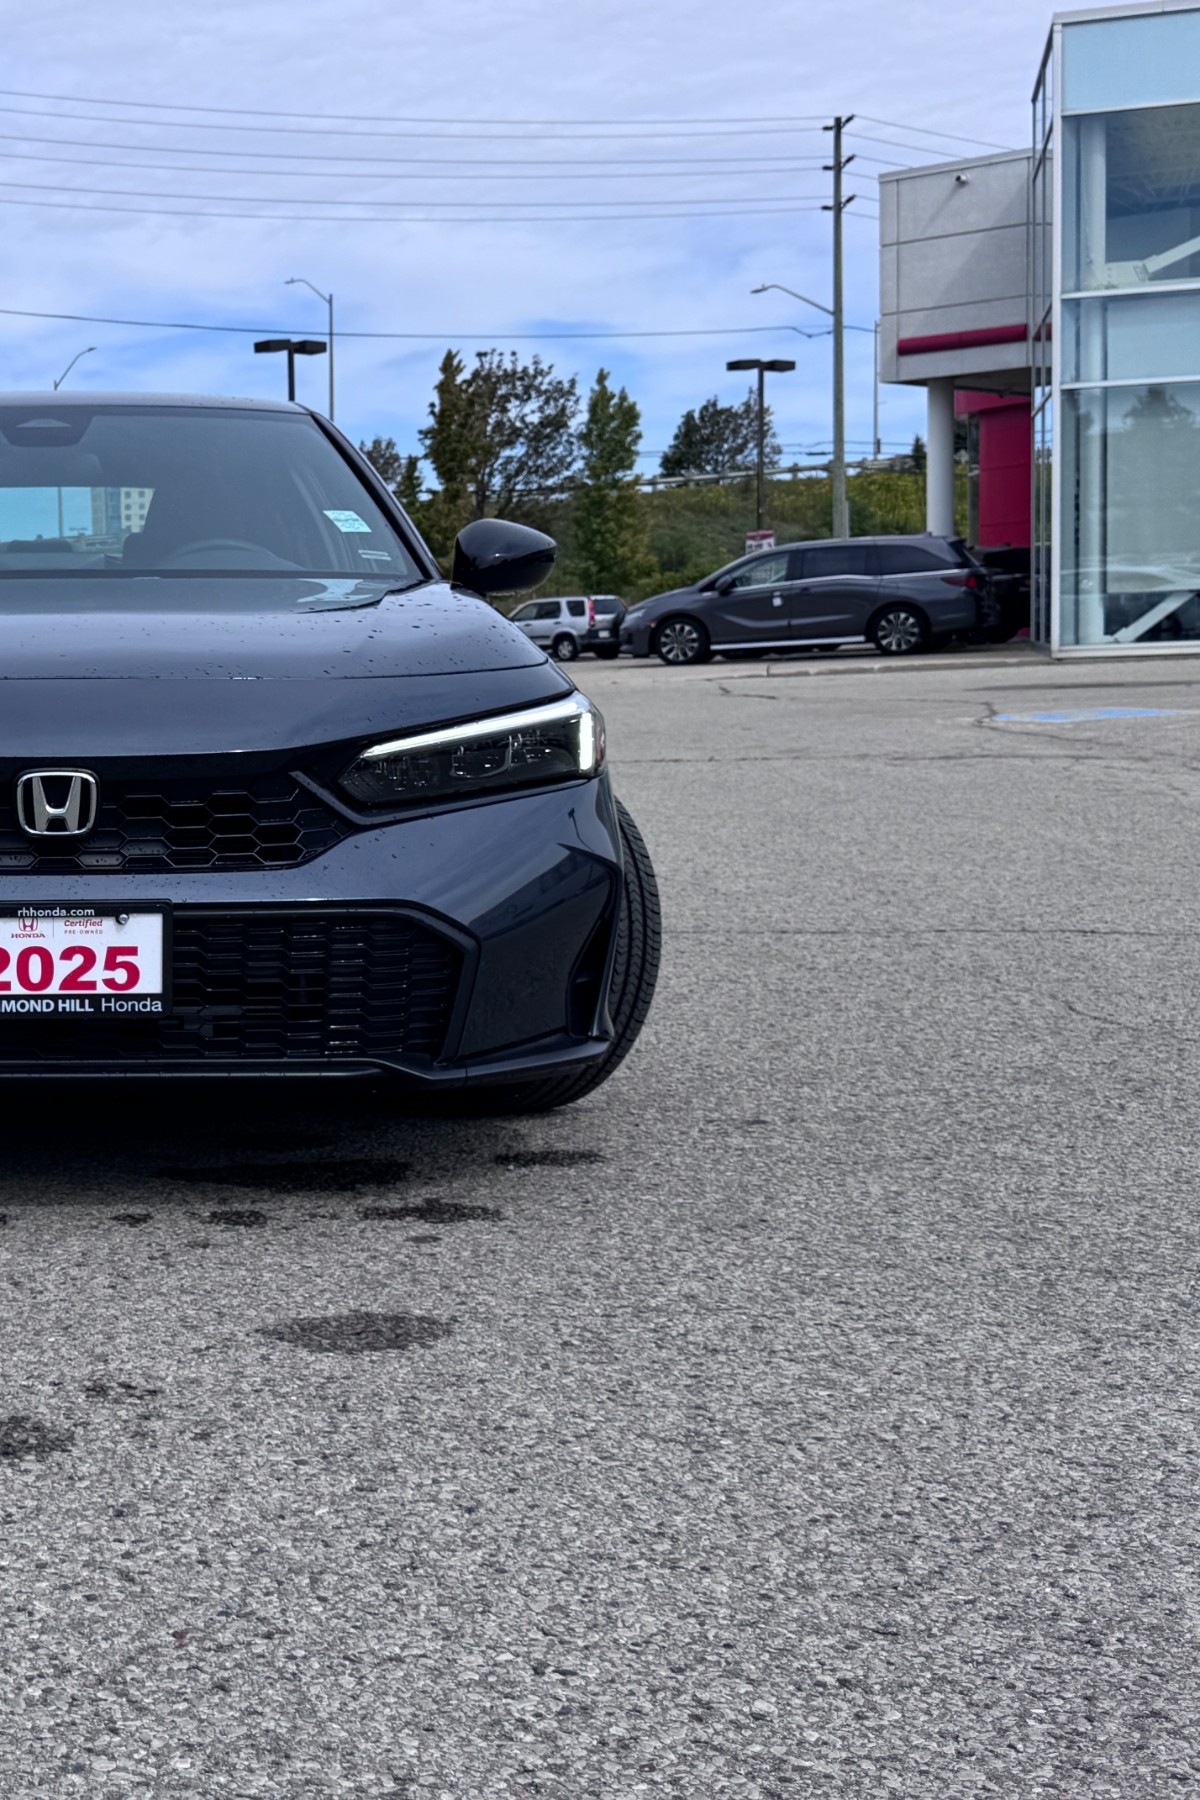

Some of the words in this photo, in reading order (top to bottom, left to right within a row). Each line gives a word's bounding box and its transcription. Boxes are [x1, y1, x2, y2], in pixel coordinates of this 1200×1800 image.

[17, 907, 95, 917] rhhonda.com
[64, 919, 103, 927] Certified
[58, 999, 94, 1012] HILL
[101, 998, 162, 1012] Honda
